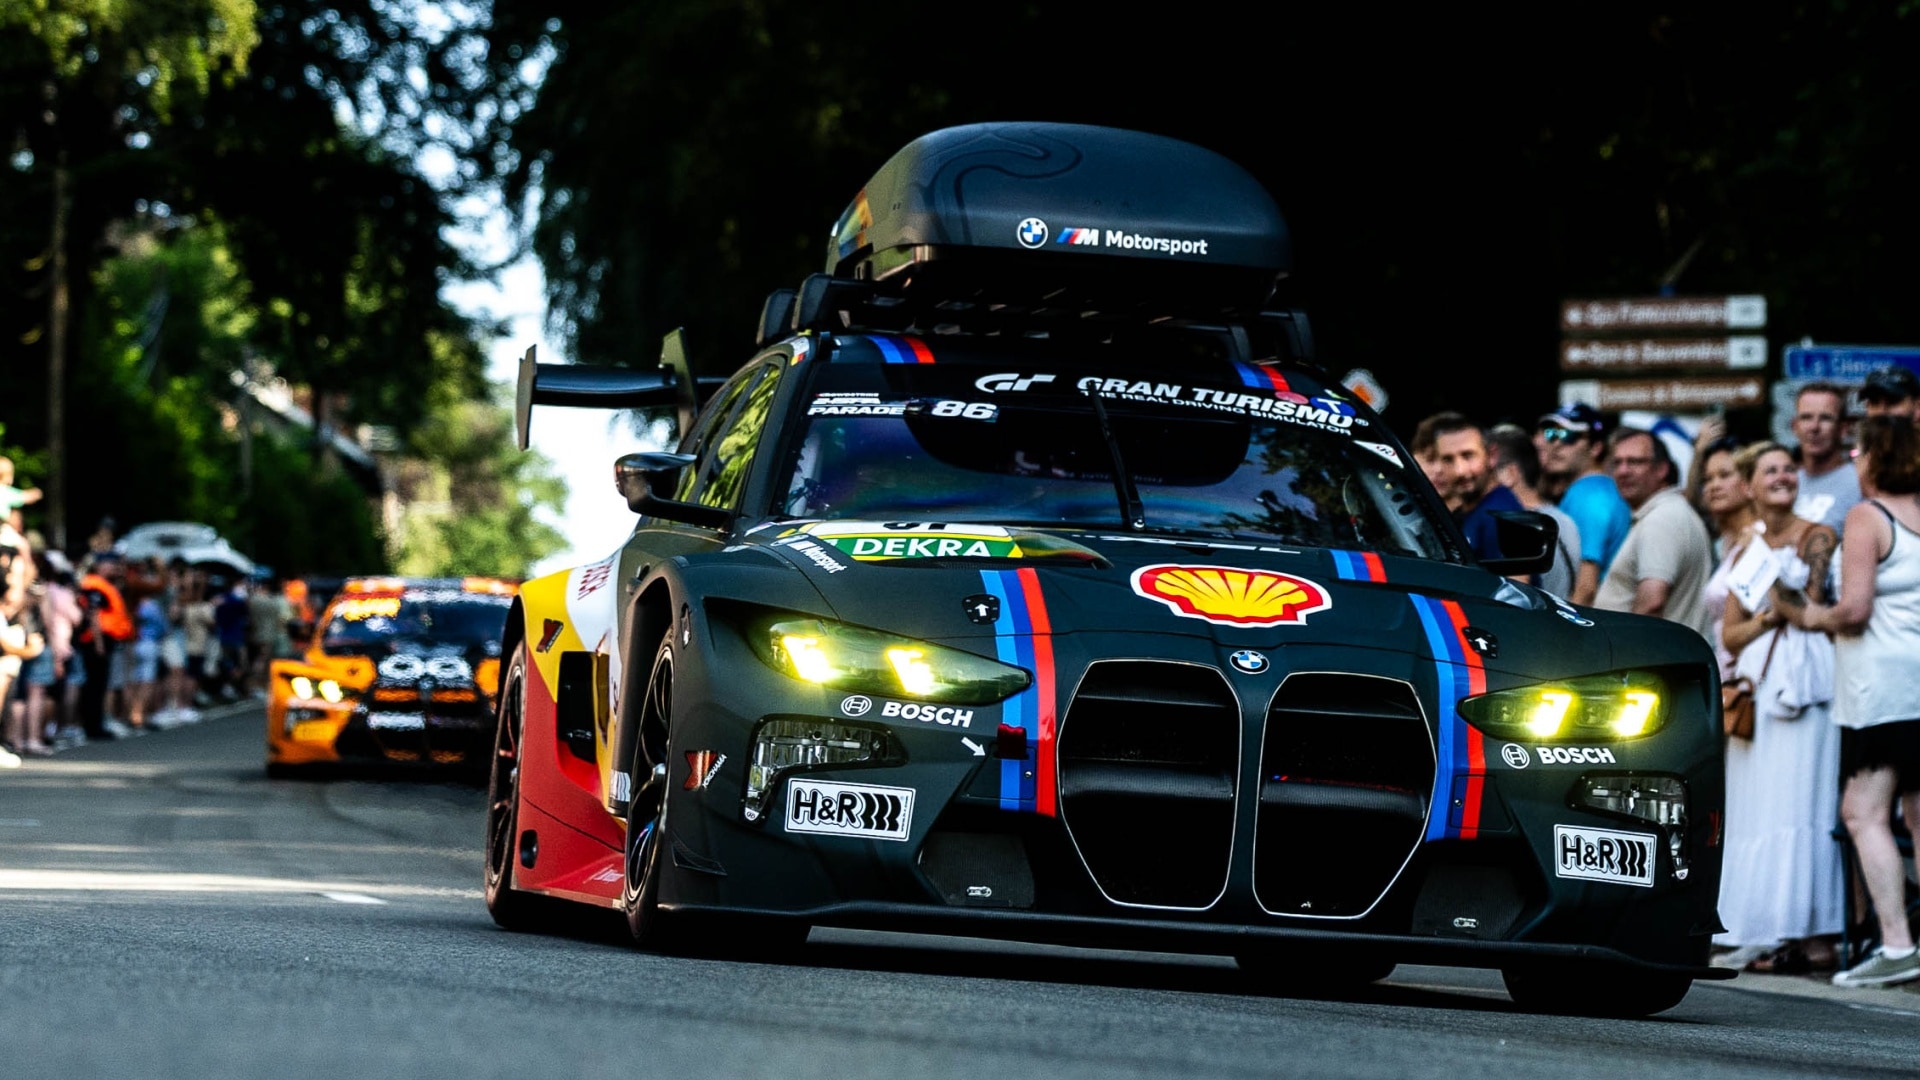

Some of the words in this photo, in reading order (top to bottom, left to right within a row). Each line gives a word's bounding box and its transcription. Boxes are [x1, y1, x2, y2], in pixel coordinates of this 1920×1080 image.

[1105, 229, 1208, 255] Motorsport
[1077, 377, 1182, 398] GRAN
[806, 406, 906, 416] PARADE
[931, 400, 998, 420] 86
[1121, 393, 1169, 404] REAL
[1172, 399, 1246, 414] DRIVING
[1250, 410, 1352, 436] SIMULATOR
[852, 537, 992, 558] DEKRA
[881, 701, 974, 728] BOSCH
[1536, 747, 1617, 764] BOSCH
[792, 788, 862, 829] H&R
[1560, 834, 1618, 874] H&R
